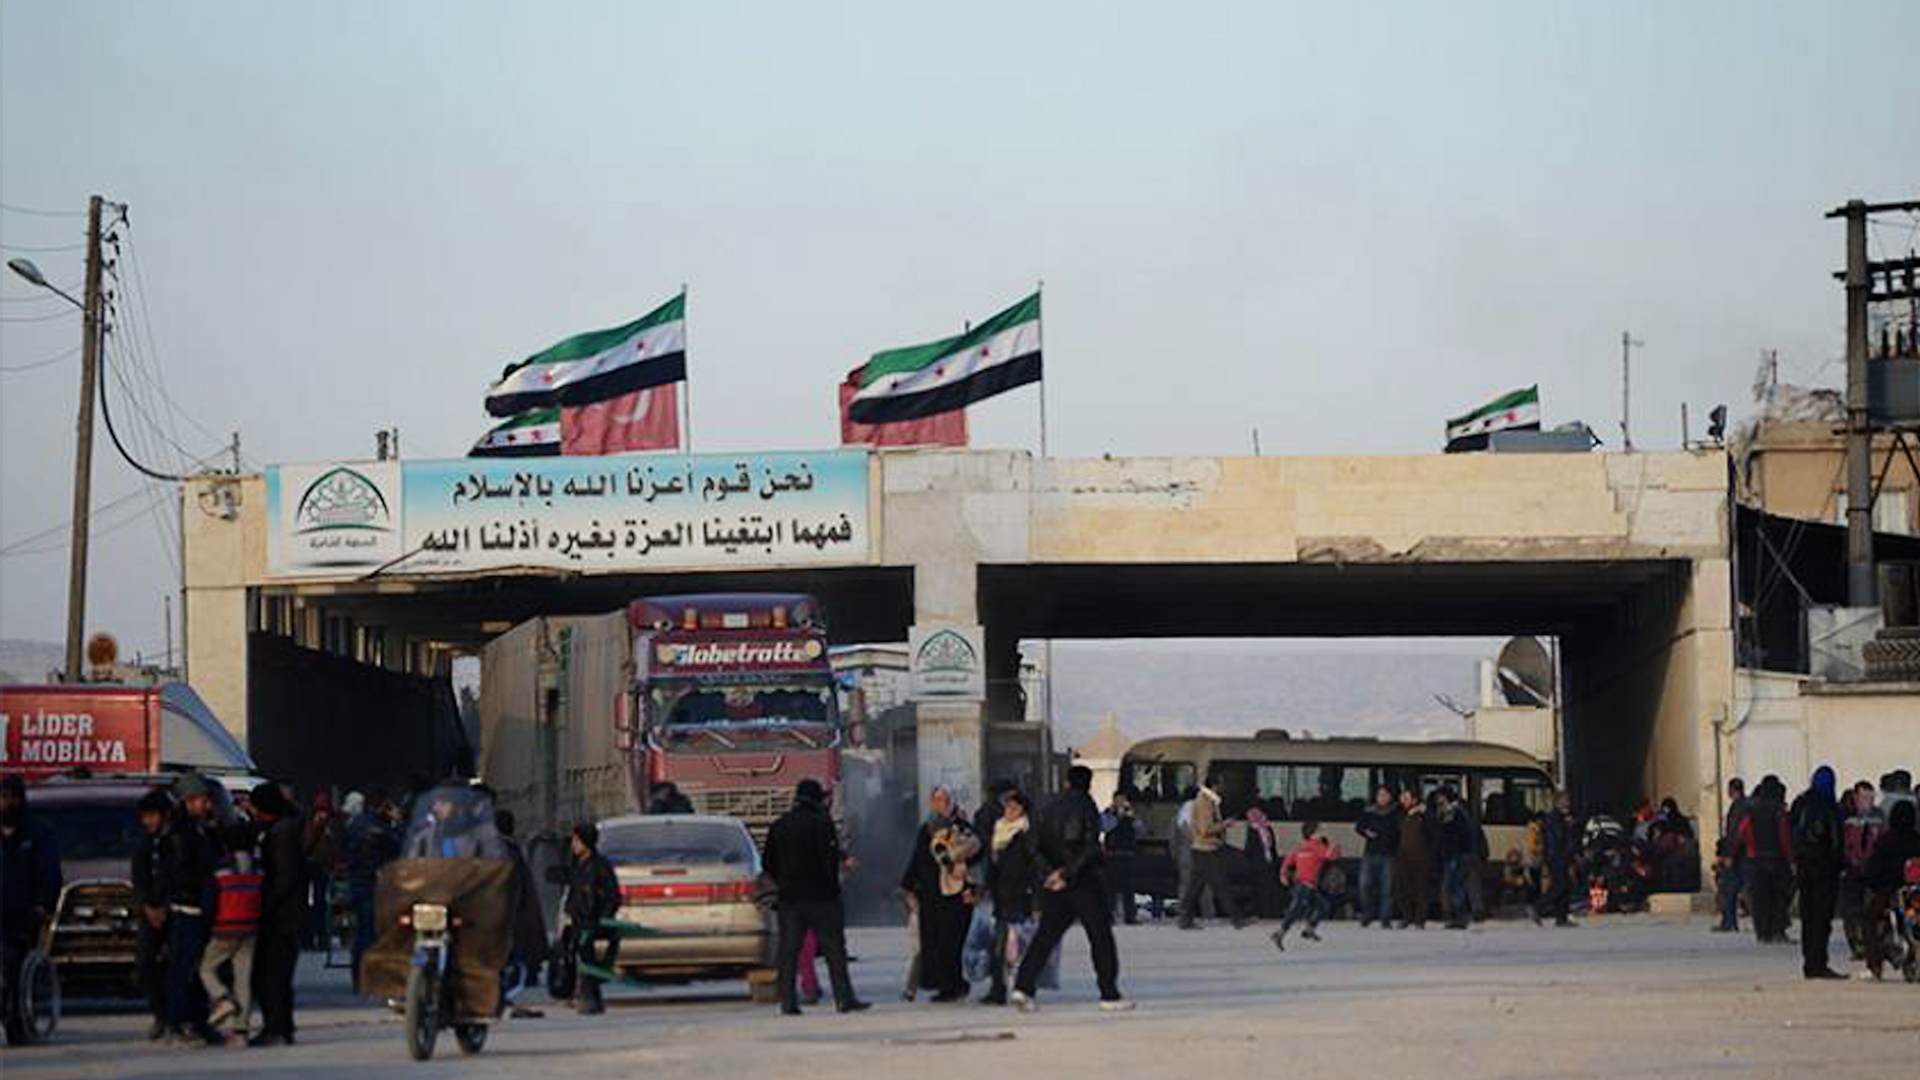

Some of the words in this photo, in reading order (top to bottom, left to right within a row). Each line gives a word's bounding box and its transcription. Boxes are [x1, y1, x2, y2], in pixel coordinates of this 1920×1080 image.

[563, 474, 616, 499] الله
[627, 463, 693, 502] أعزنا
[703, 464, 752, 502] قوم
[760, 464, 814, 501] نحن
[422, 524, 470, 553] الله
[481, 518, 540, 551] أذلنا
[547, 528, 616, 560] بغيره
[625, 519, 692, 557] العزة
[703, 517, 782, 553] ابتغينا
[792, 513, 852, 545] فمهما
[22, 708, 93, 735] LİDER
[22, 737, 126, 763] MOBİLYA
